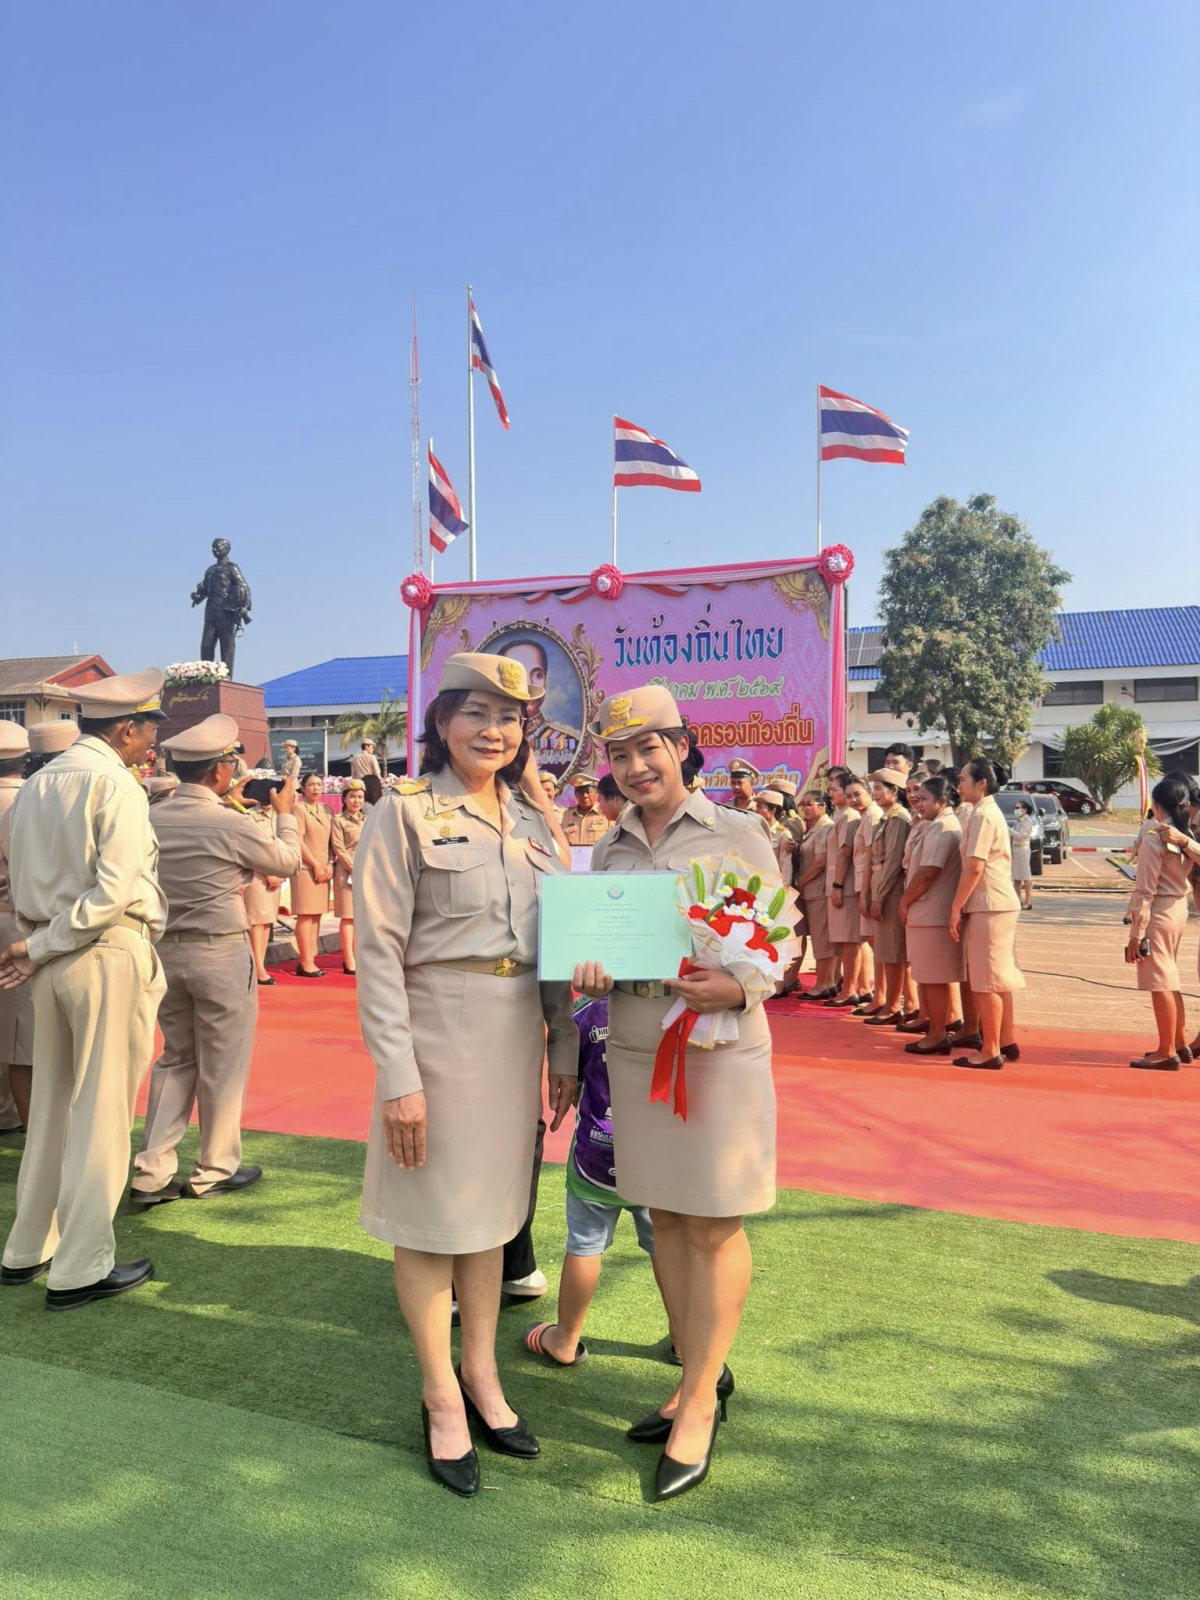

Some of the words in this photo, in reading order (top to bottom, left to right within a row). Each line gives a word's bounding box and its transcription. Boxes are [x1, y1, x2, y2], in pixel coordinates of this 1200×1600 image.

[612, 601, 784, 669] วันท้องถิ่นไทย
[703, 676, 739, 698] พ.ศ.
